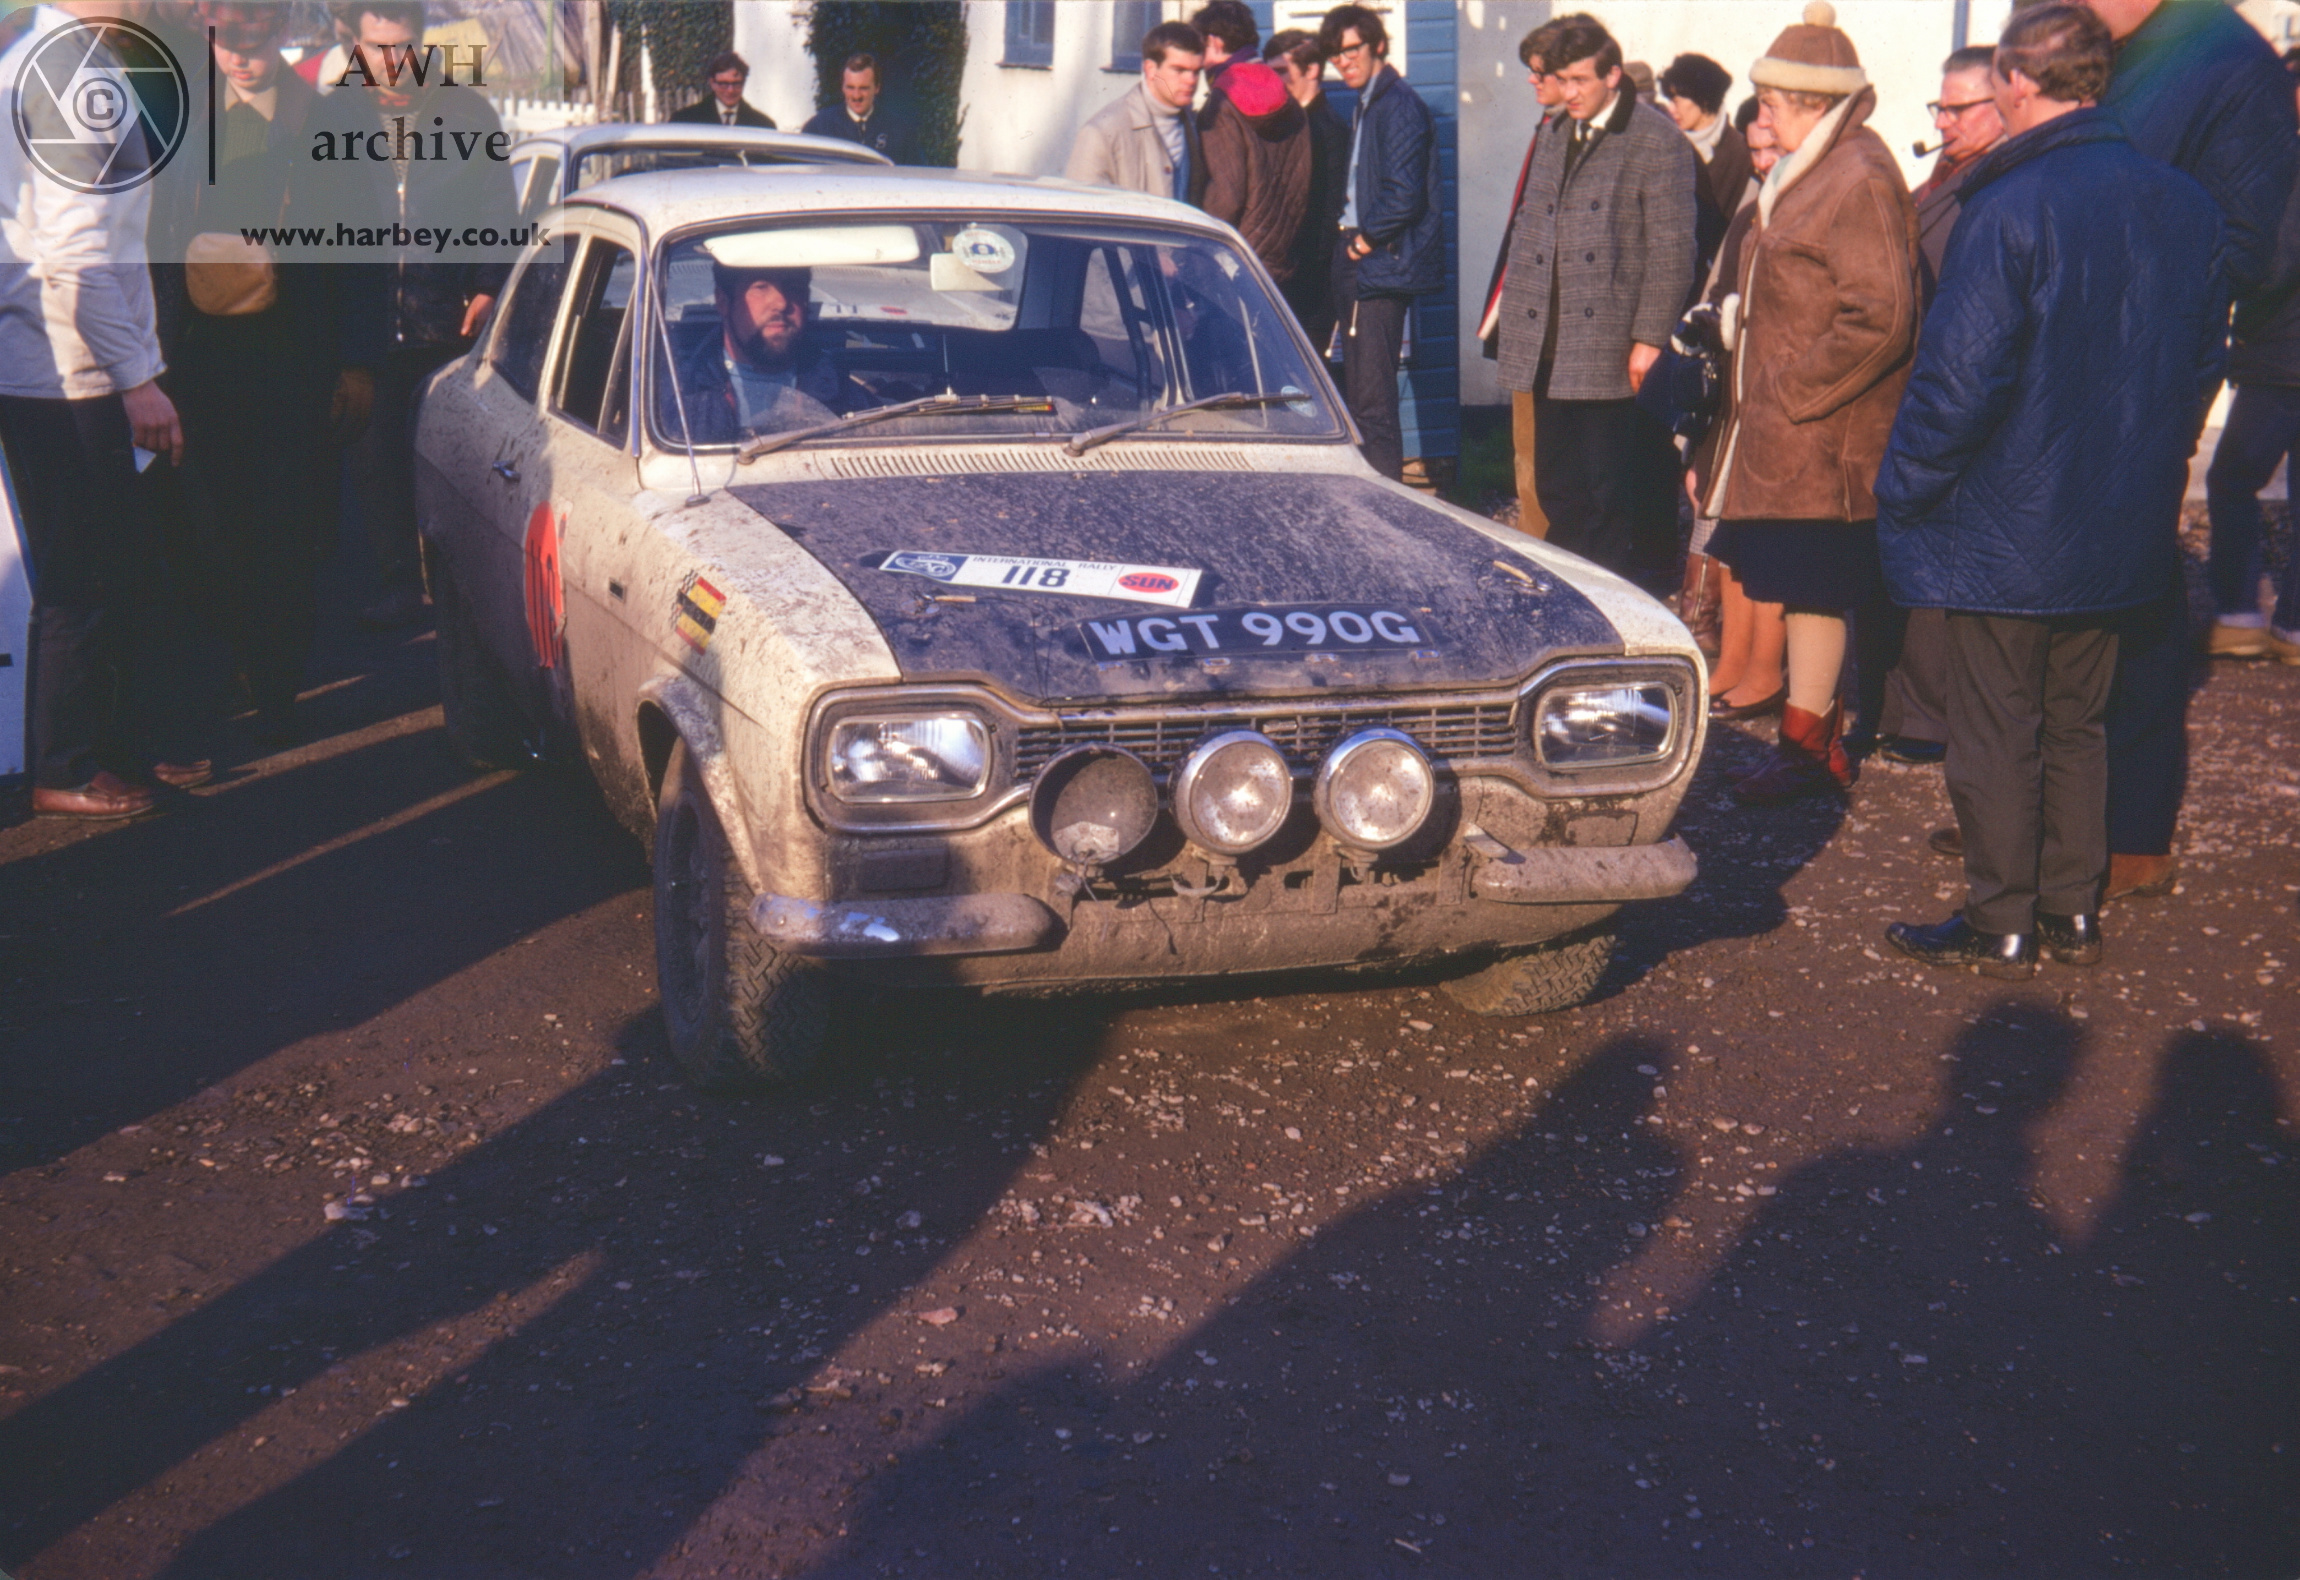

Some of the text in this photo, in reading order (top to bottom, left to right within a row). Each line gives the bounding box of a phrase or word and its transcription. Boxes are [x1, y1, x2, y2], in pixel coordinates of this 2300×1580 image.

[972, 556, 1118, 571] INTERNATIONAL RALLY
[1001, 565, 1072, 588] 118
[1121, 574, 1175, 591] SUN
[1088, 609, 1422, 655] WGT 990G
